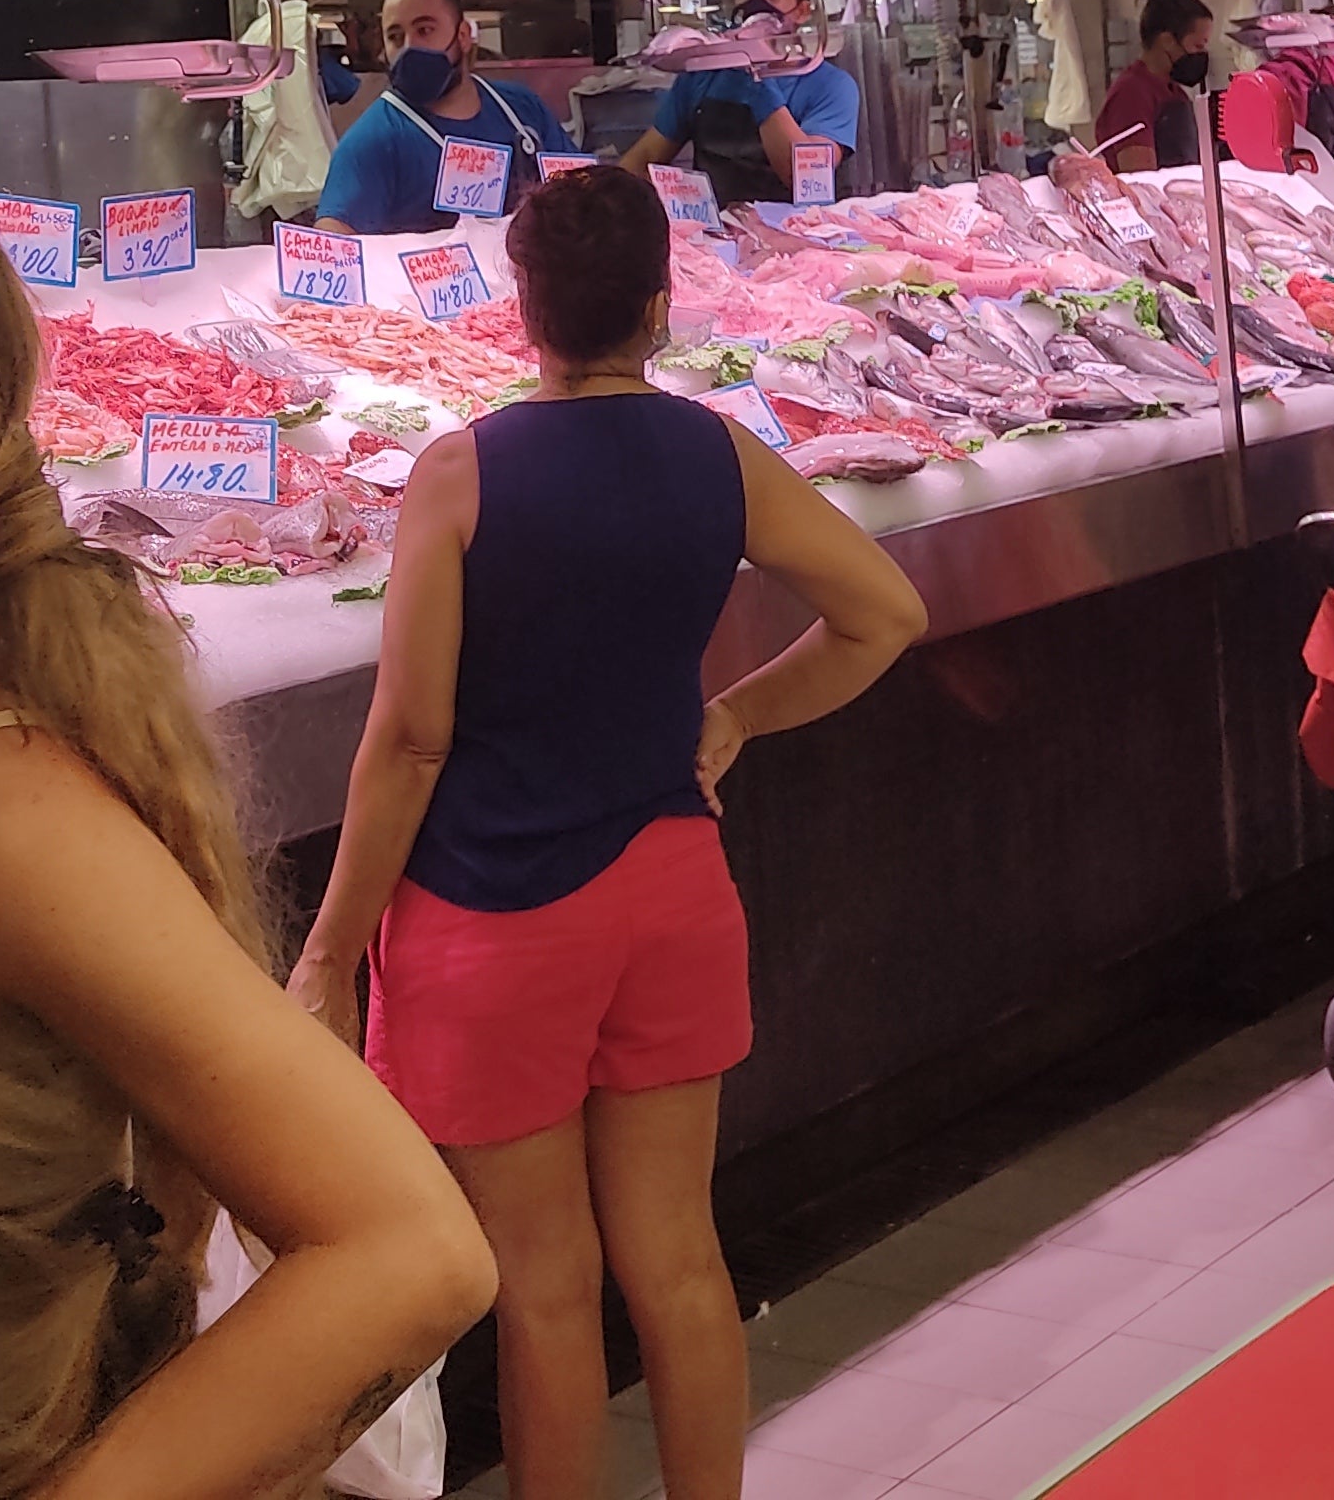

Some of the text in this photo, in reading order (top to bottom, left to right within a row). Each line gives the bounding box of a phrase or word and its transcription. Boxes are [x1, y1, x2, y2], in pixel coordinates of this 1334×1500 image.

[283, 230, 333, 251] GAMBA
[151, 421, 252, 438] MERLUZA
[150, 440, 207, 453] ENTERA
